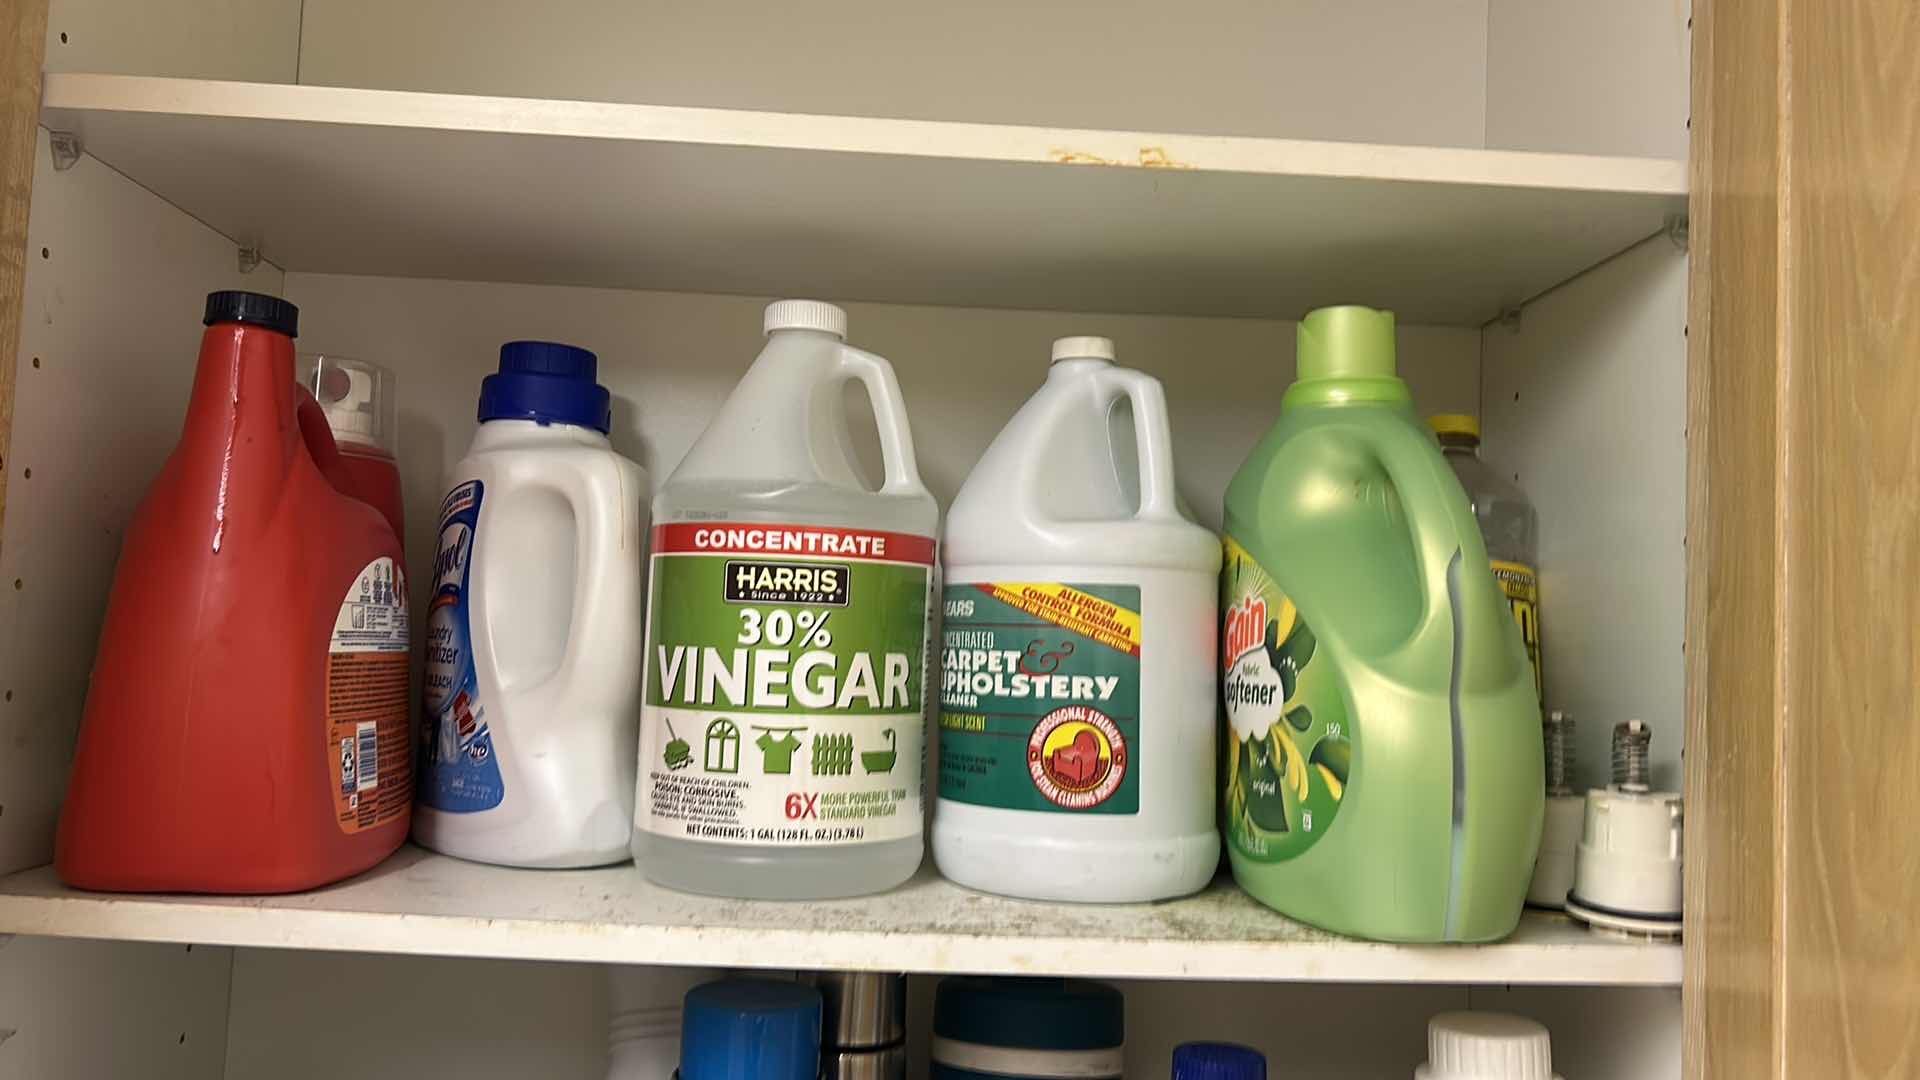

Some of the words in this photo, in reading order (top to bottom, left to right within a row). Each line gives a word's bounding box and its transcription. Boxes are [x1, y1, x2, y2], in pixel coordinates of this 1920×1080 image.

[695, 529, 885, 556] CONCENTRATE
[737, 566, 838, 593] HARRIS
[751, 590, 787, 600] Since
[793, 591, 824, 601] 1922
[944, 599, 975, 617] EARS
[1058, 588, 1118, 618] ALLERGEN
[1021, 586, 1073, 614] CONTROL
[1075, 608, 1132, 638] FORMULA
[737, 607, 833, 649] 30%
[941, 649, 1022, 673] CARPET
[657, 643, 911, 710] VINEGAR
[941, 671, 1120, 701] UPHOLSTERY
[1226, 675, 1277, 713] softener
[965, 714, 986, 733] SCENT
[784, 791, 819, 820] 6X
[820, 791, 848, 806] MORE
[848, 789, 889, 805] POWERFUL
[891, 788, 907, 801] THAN
[1057, 791, 1098, 809] CLEANING
[820, 803, 866, 821] STANDARD
[866, 802, 897, 818] VINEGAR
[686, 823, 702, 836] NET
[702, 824, 748, 839] CONTENTS:
[776, 828, 799, 841] (128
[799, 828, 813, 840] FL.
[815, 827, 833, 841] OZ.)
